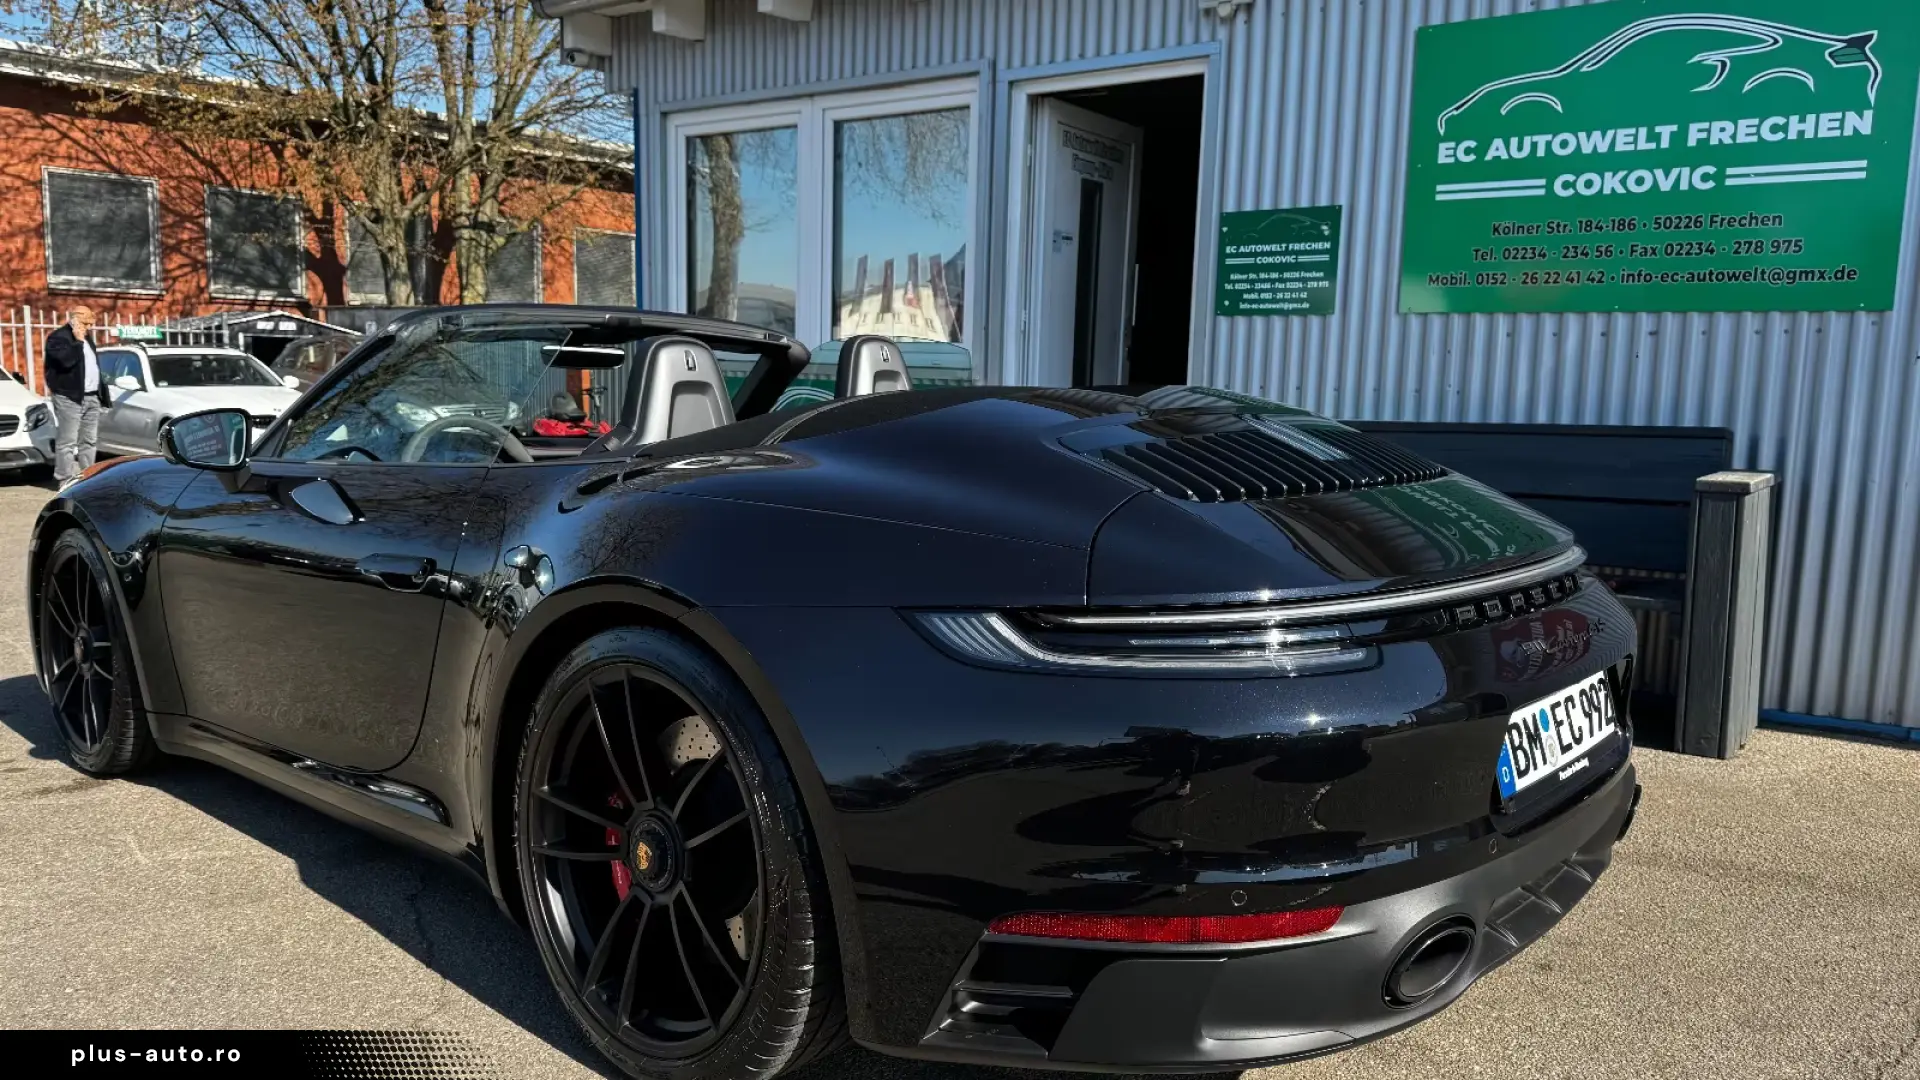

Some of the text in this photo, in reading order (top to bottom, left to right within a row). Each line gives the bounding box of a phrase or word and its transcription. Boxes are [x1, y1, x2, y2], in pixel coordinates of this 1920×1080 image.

[1437, 109, 1873, 164] EC AUTOWELT FRECHEN
[1553, 165, 1717, 197] COKOVIC
[1492, 211, 1783, 237] Kölner Str. 184-186 50226 Frechen
[1225, 241, 1331, 254] EC AUTOWELT FRECHEN
[1256, 255, 1297, 264] COKOVIC
[1473, 247, 1498, 261] Tel.
[1502, 246, 1547, 261] 02234
[1561, 245, 1590, 260] 234
[1594, 244, 1614, 259] 56
[1629, 243, 1658, 258] Fax
[1664, 241, 1716, 257] 02234
[1733, 239, 1765, 255] 278
[1770, 239, 1804, 254] 975
[1427, 272, 1471, 286] Mobil.
[1475, 272, 1507, 286] 0152
[1521, 271, 1538, 285] 26
[1542, 271, 1561, 285] 22
[1565, 271, 1581, 284] 41
[1586, 270, 1605, 284] 42
[1620, 265, 1858, 285] info-ec-autowelt@gmx.de
[1506, 713, 1548, 780] BM
[1550, 694, 1584, 755] EC
